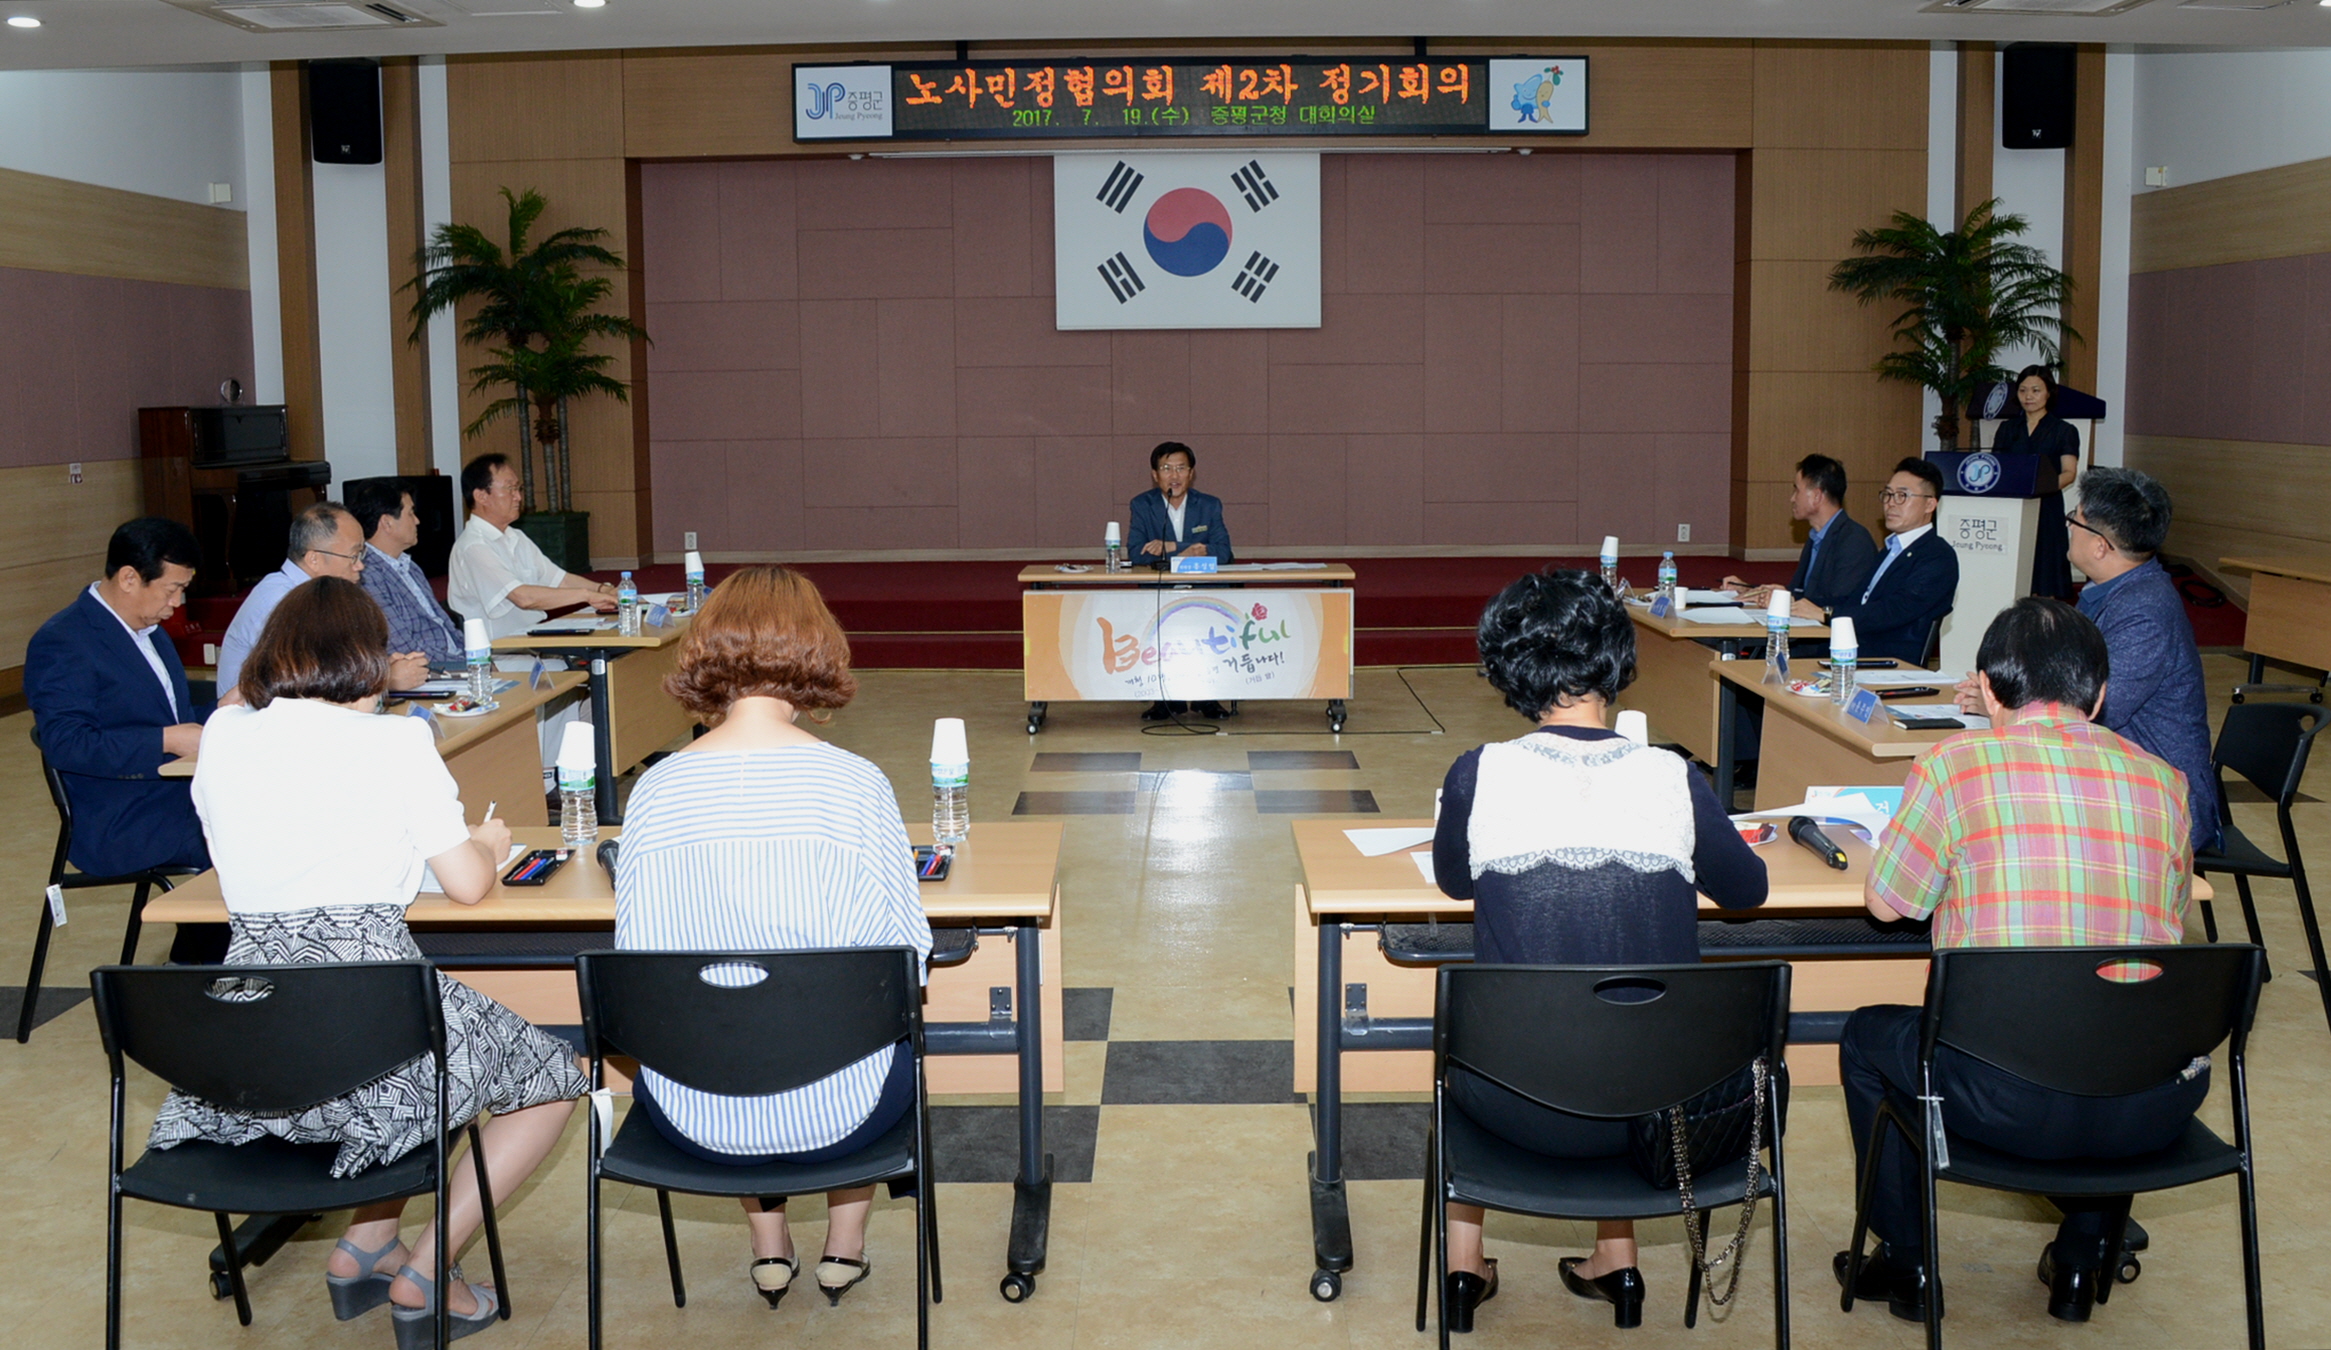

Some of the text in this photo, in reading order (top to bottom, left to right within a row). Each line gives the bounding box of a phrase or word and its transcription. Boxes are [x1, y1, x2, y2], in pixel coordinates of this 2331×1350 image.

[905, 62, 1469, 108] 노사민정협의회 제2차 정기회의
[848, 90, 883, 111] 증평군
[1012, 108, 1060, 127] 2017.
[1082, 108, 1099, 126] 7.
[1210, 105, 1288, 125] 증평군청
[1299, 104, 1376, 125] 대회의실
[1959, 518, 1998, 541] 증평군
[1222, 651, 1286, 674] 거듭나다!
